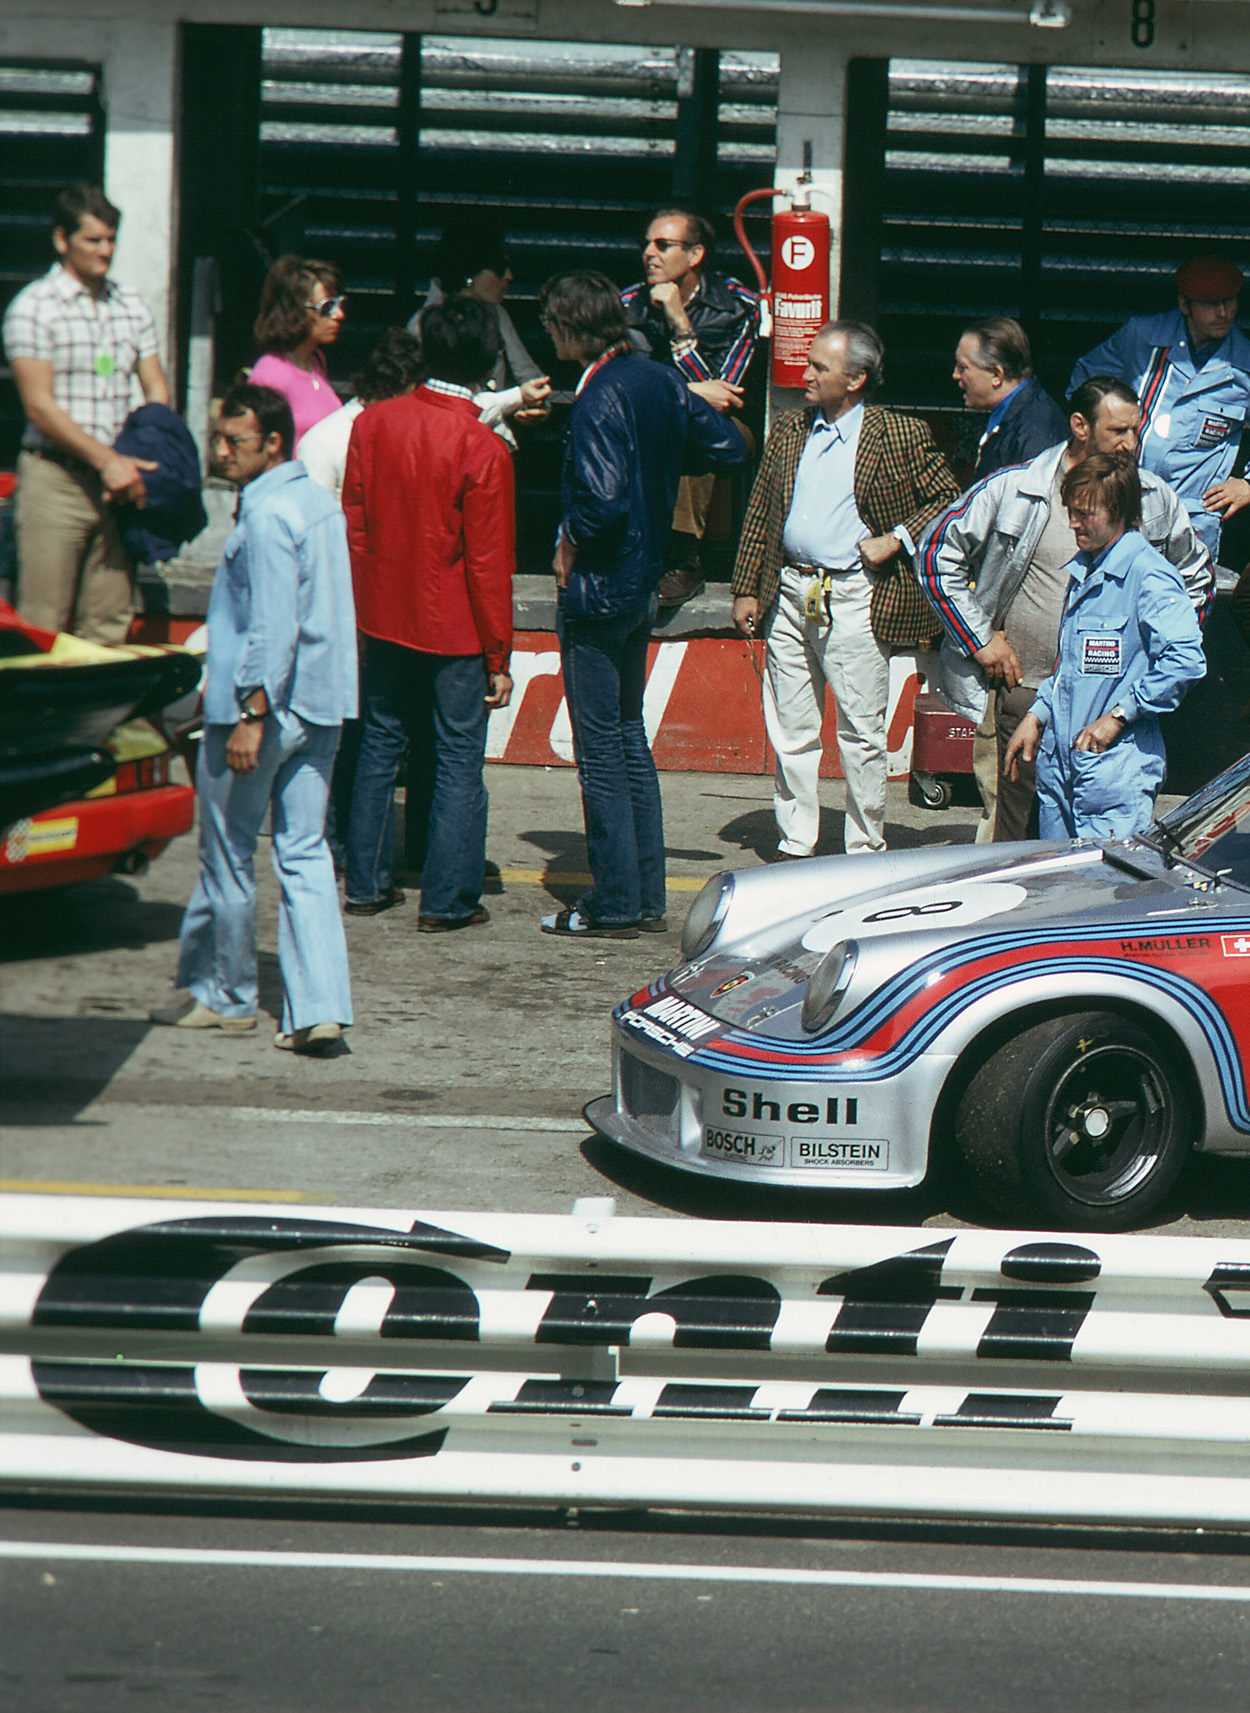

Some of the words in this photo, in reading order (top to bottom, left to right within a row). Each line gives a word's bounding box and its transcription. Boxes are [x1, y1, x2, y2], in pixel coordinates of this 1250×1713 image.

[1132, 0, 1155, 49] 8
[862, 900, 963, 923] 8
[620, 1011, 695, 1058] PORSCHE
[643, 996, 721, 1041] MARTINI
[722, 1088, 858, 1125] Shell
[706, 1129, 756, 1156] BOSCH
[799, 1143, 881, 1159] BILSTEIN
[831, 1159, 875, 1167] ABSORBERS
[31, 1216, 1102, 1462] Conti
